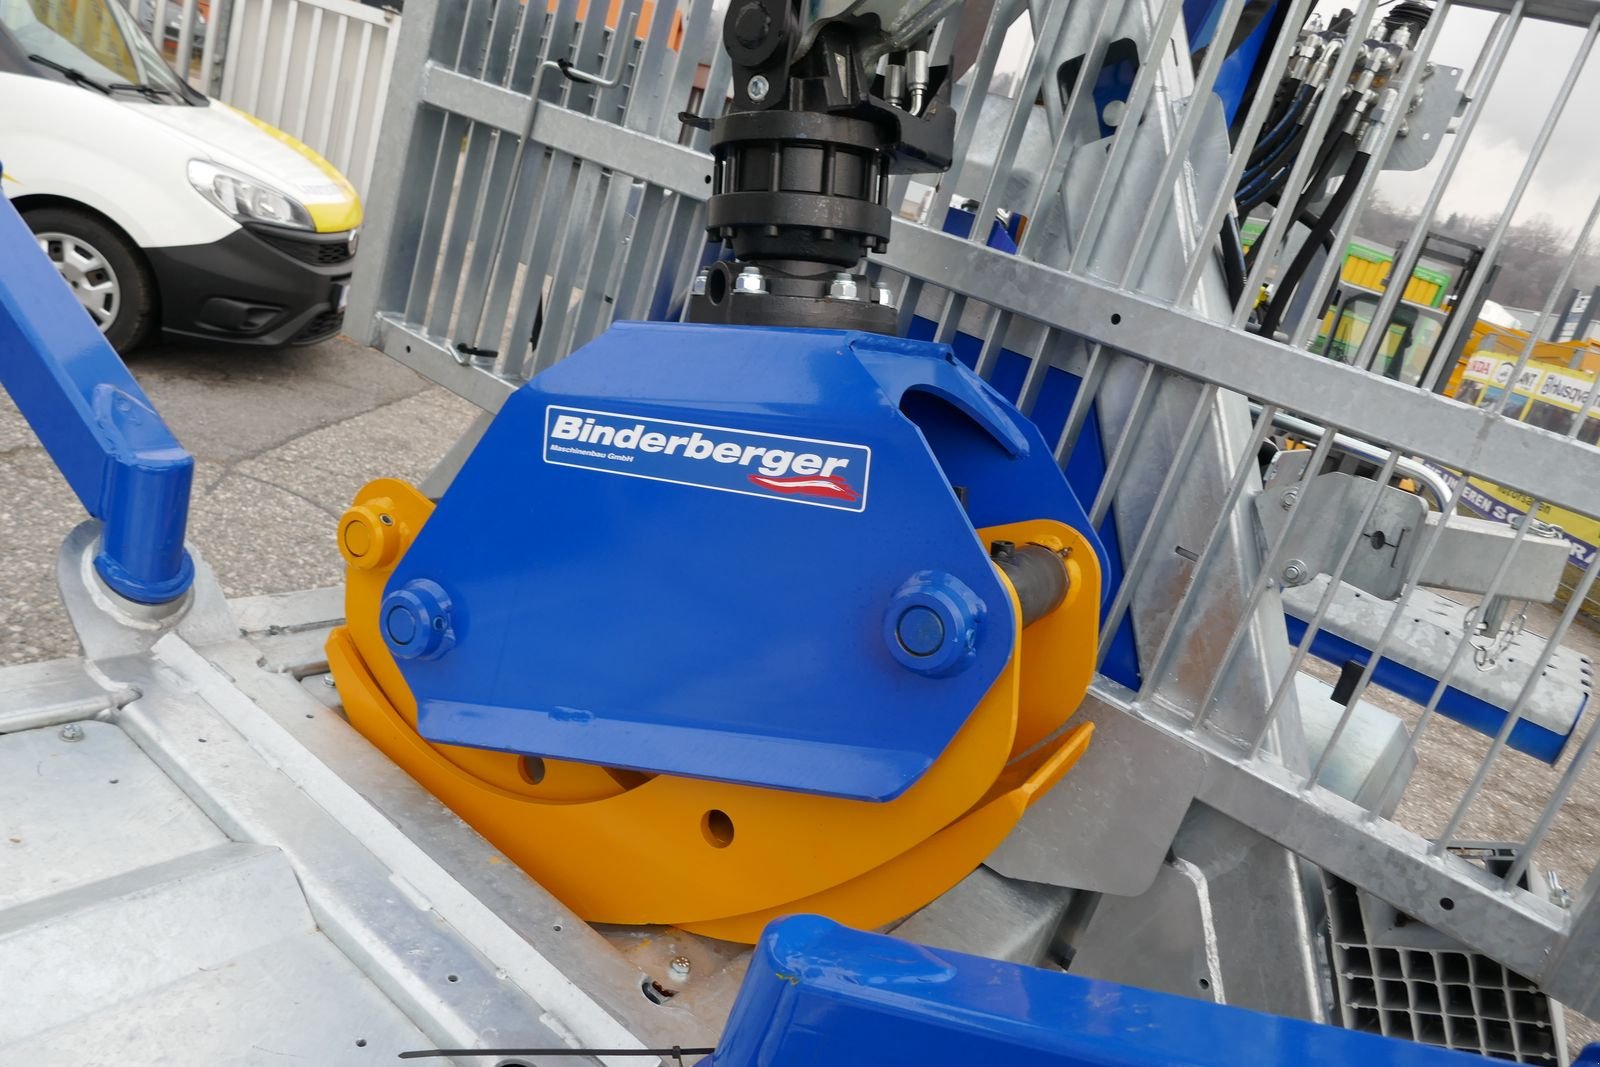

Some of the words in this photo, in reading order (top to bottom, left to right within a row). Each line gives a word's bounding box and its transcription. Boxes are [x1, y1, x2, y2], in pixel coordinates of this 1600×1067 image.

[550, 444, 606, 459] Maschinenbau
[607, 452, 635, 463] GmbH
[551, 414, 849, 477] Binderberger
